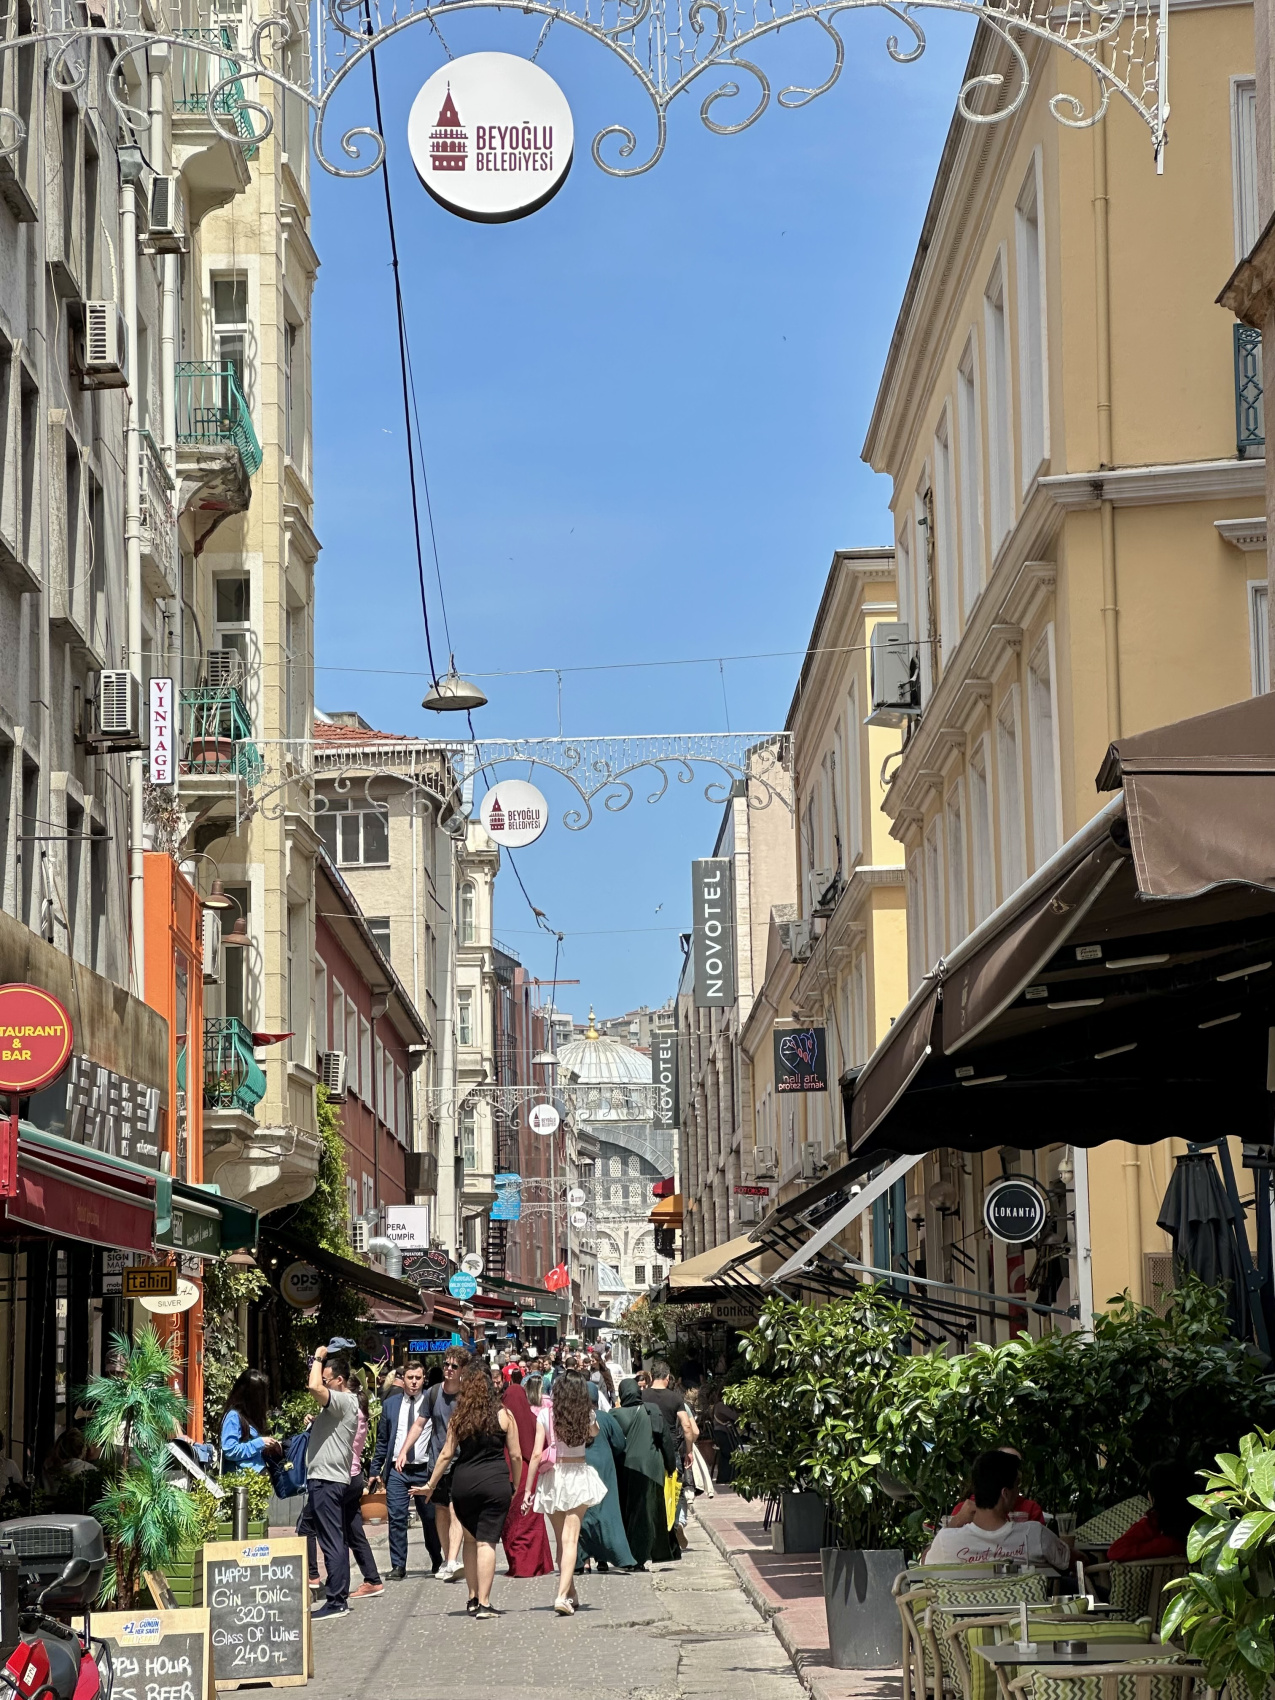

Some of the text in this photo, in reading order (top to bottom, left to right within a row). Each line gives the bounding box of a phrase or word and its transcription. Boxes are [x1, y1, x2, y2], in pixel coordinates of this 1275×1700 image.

[476, 121, 552, 150] BEYOĞLU
[154, 682, 168, 780] VINTAGE
[704, 870, 724, 997] NOVOTEL
[12, 1038, 22, 1048] &
[2, 1050, 31, 1060] BAR
[660, 1038, 672, 1123] NOVOTEL
[783, 1074, 818, 1082] nail art
[994, 1206, 1036, 1218] LOKANTA
[386, 1232, 414, 1241] KUMPİR
[107, 1254, 128, 1262] SIGN
[128, 1271, 168, 1288] tahin
[290, 1274, 318, 1286] OPS
[408, 1271, 438, 1282] VINTAGE
[158, 1300, 182, 1308] SILVER
[956, 1547, 991, 1562] Saint
[214, 1564, 294, 1584] HAPPY HOUR
[234, 1606, 283, 1624] 320 TL
[122, 1622, 135, 1634] +1
[248, 1626, 264, 1642] OF
[232, 1644, 288, 1667] 240 TL
